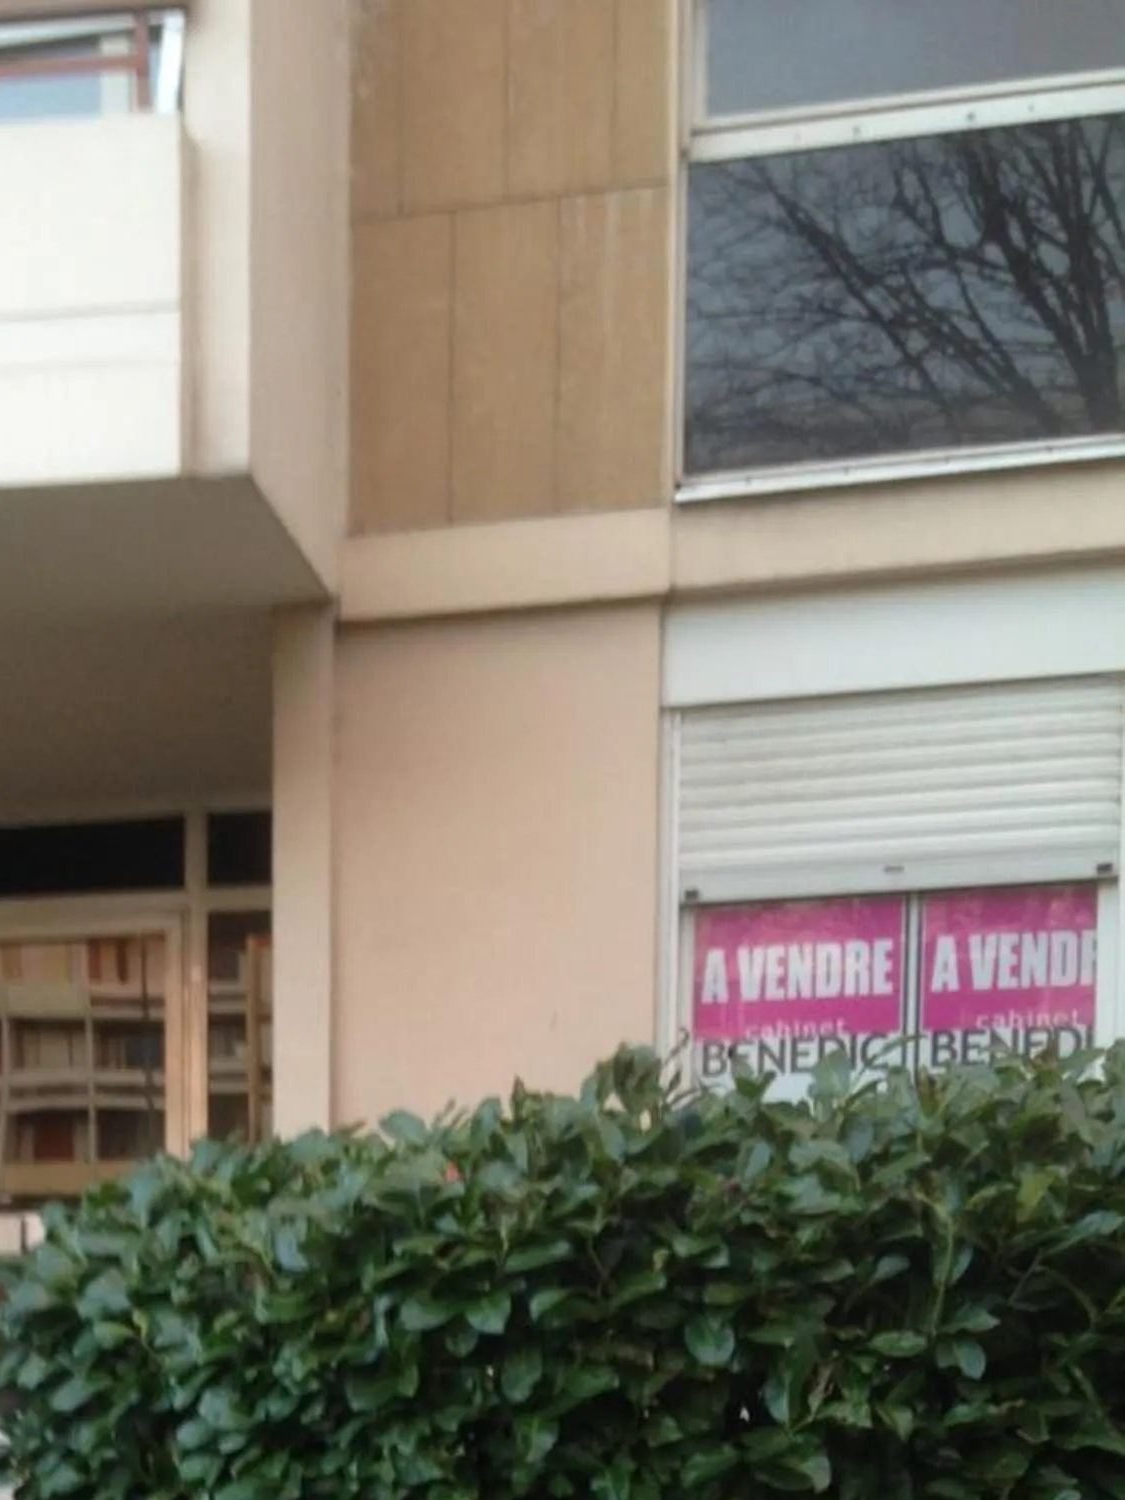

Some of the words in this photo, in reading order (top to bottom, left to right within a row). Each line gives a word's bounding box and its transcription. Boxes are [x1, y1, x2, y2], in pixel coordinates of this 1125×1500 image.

[702, 949, 729, 1004] A
[737, 938, 893, 1003] VENDRE
[931, 935, 960, 993] A
[975, 1007, 1081, 1030] cabinet
